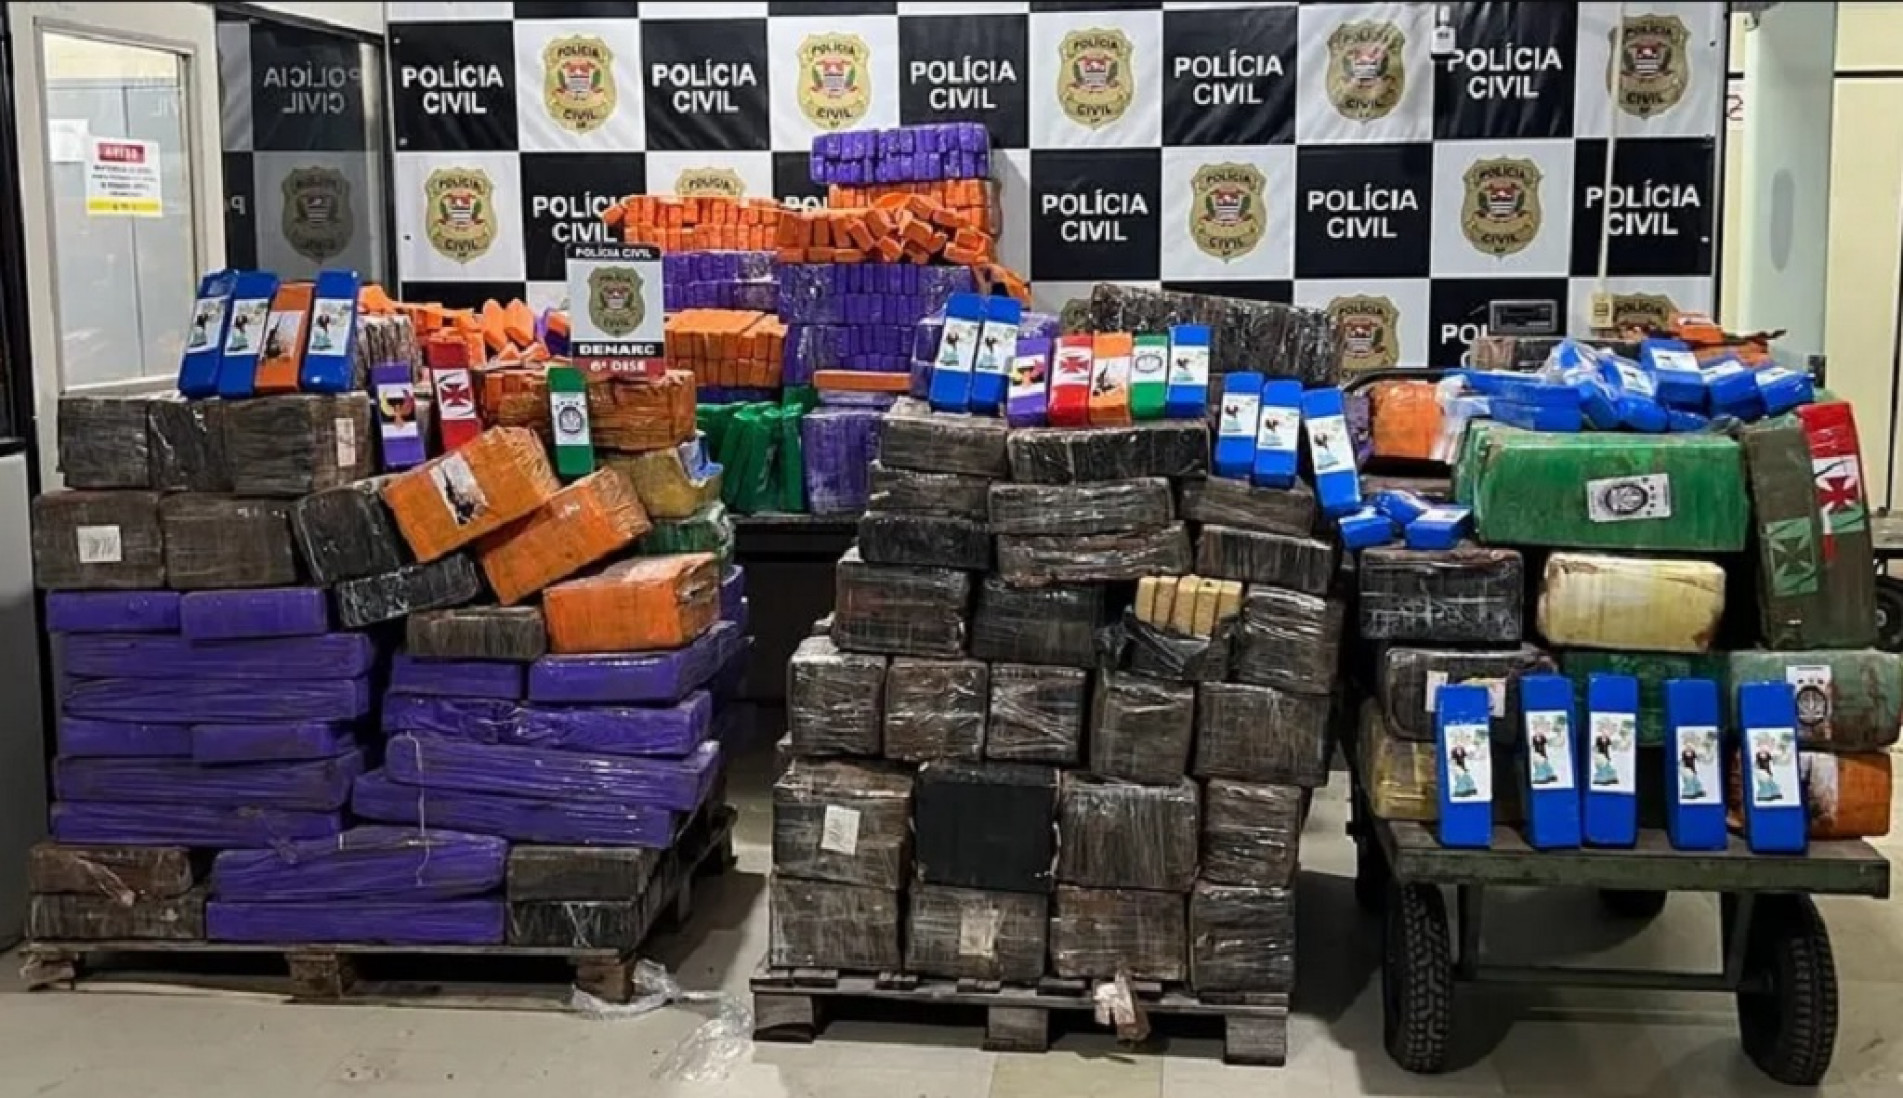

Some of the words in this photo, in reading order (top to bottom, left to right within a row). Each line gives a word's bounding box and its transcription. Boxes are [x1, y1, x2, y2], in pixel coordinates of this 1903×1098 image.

[1174, 48, 1284, 78] POLÍCIA
[1448, 42, 1562, 72] POLÍCIA
[401, 60, 504, 88] POLÍCIA
[652, 58, 757, 87] POLÍCIA
[910, 55, 1017, 85] POLÍCIA
[928, 86, 998, 109] CIVIL
[1193, 82, 1263, 105] CIVIL
[1468, 75, 1539, 100] CIVIL
[423, 91, 488, 115] CIVIL
[563, 107, 597, 120] CIVIL
[672, 90, 740, 114] CIVIL
[816, 107, 854, 119] CIVIL
[1077, 103, 1112, 116] CIVIL
[532, 190, 617, 219] POLÍC
[1041, 188, 1149, 216] POLÍCIA
[1307, 182, 1418, 212] POLÍCIA
[1585, 178, 1701, 209] POLÍCIA
[552, 222, 618, 243] CIVIL
[1060, 220, 1128, 243] CIVIL
[1326, 216, 1398, 239] CIVIL
[1608, 211, 1679, 237] CIVIL
[444, 238, 479, 251] CIVIL
[1210, 237, 1244, 250] CIVIL
[1481, 233, 1519, 244] CIVIL
[621, 247, 652, 259] CIVIL
[579, 343, 656, 356] DENARC
